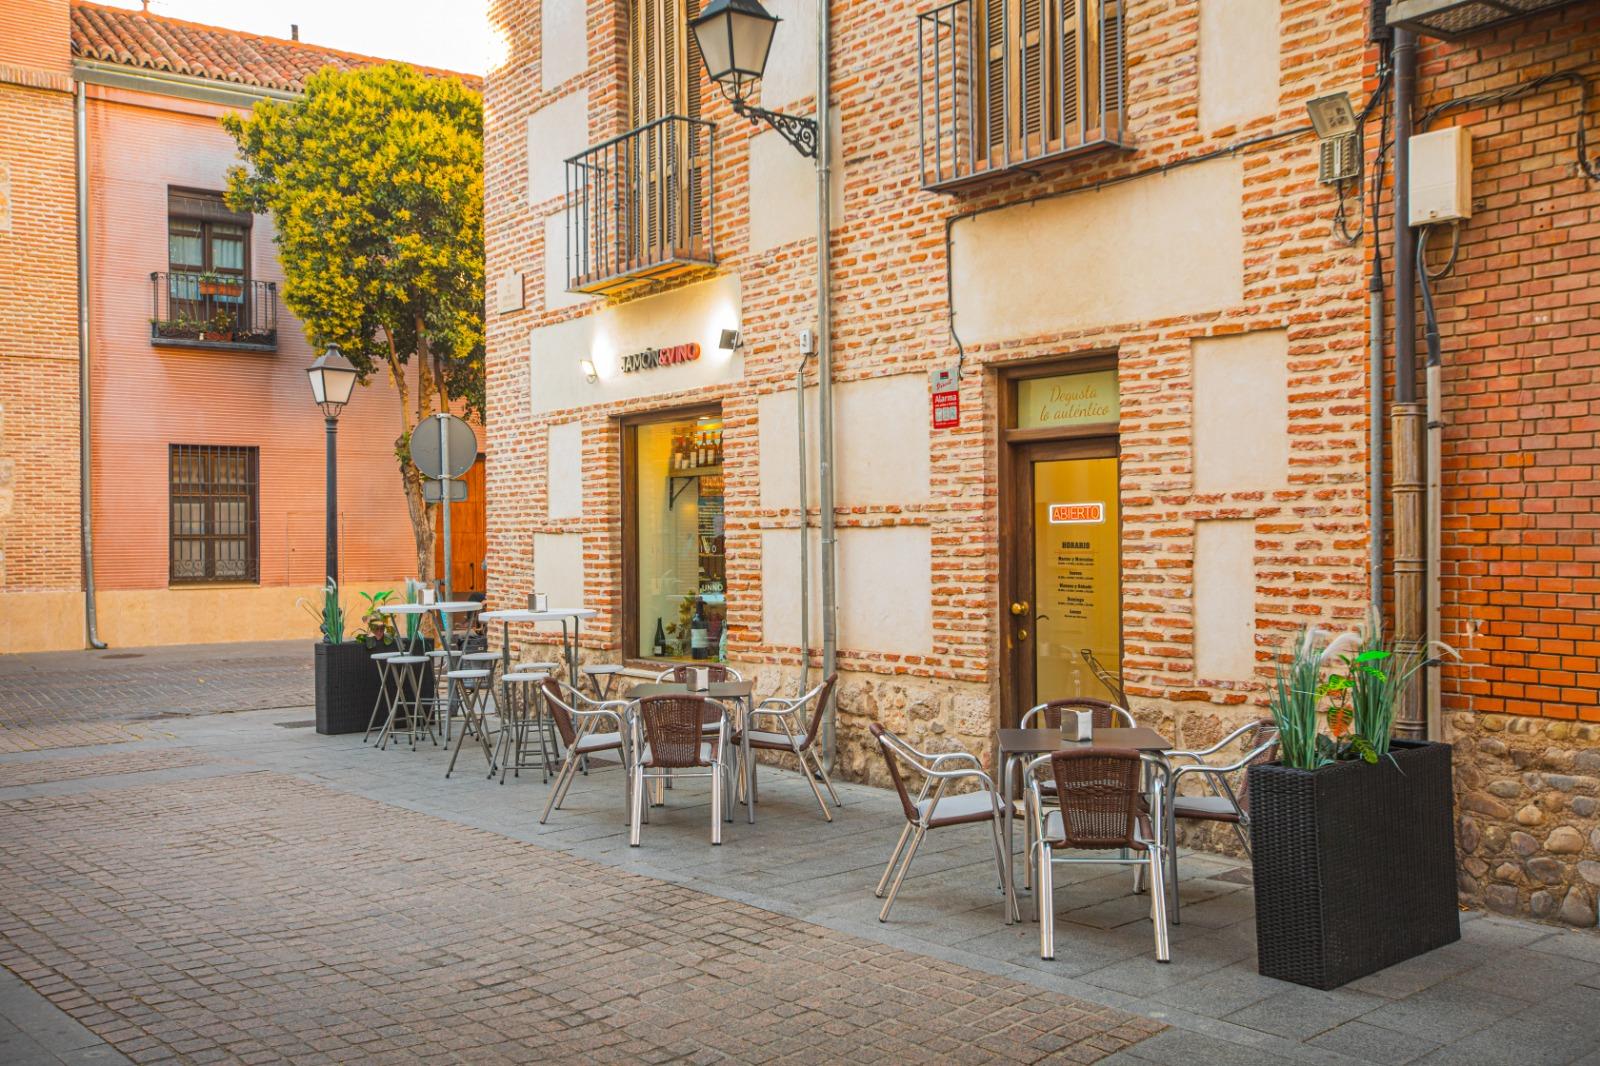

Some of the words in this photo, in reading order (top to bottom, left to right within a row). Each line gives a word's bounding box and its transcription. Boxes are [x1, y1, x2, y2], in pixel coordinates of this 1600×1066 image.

[621, 342, 701, 373] JAMÓN&VINO
[934, 394, 957, 404] Alarma
[1049, 384, 1098, 406] Degusta
[1053, 506, 1100, 520] ABIERTO
[1062, 541, 1090, 549] HORARIO
